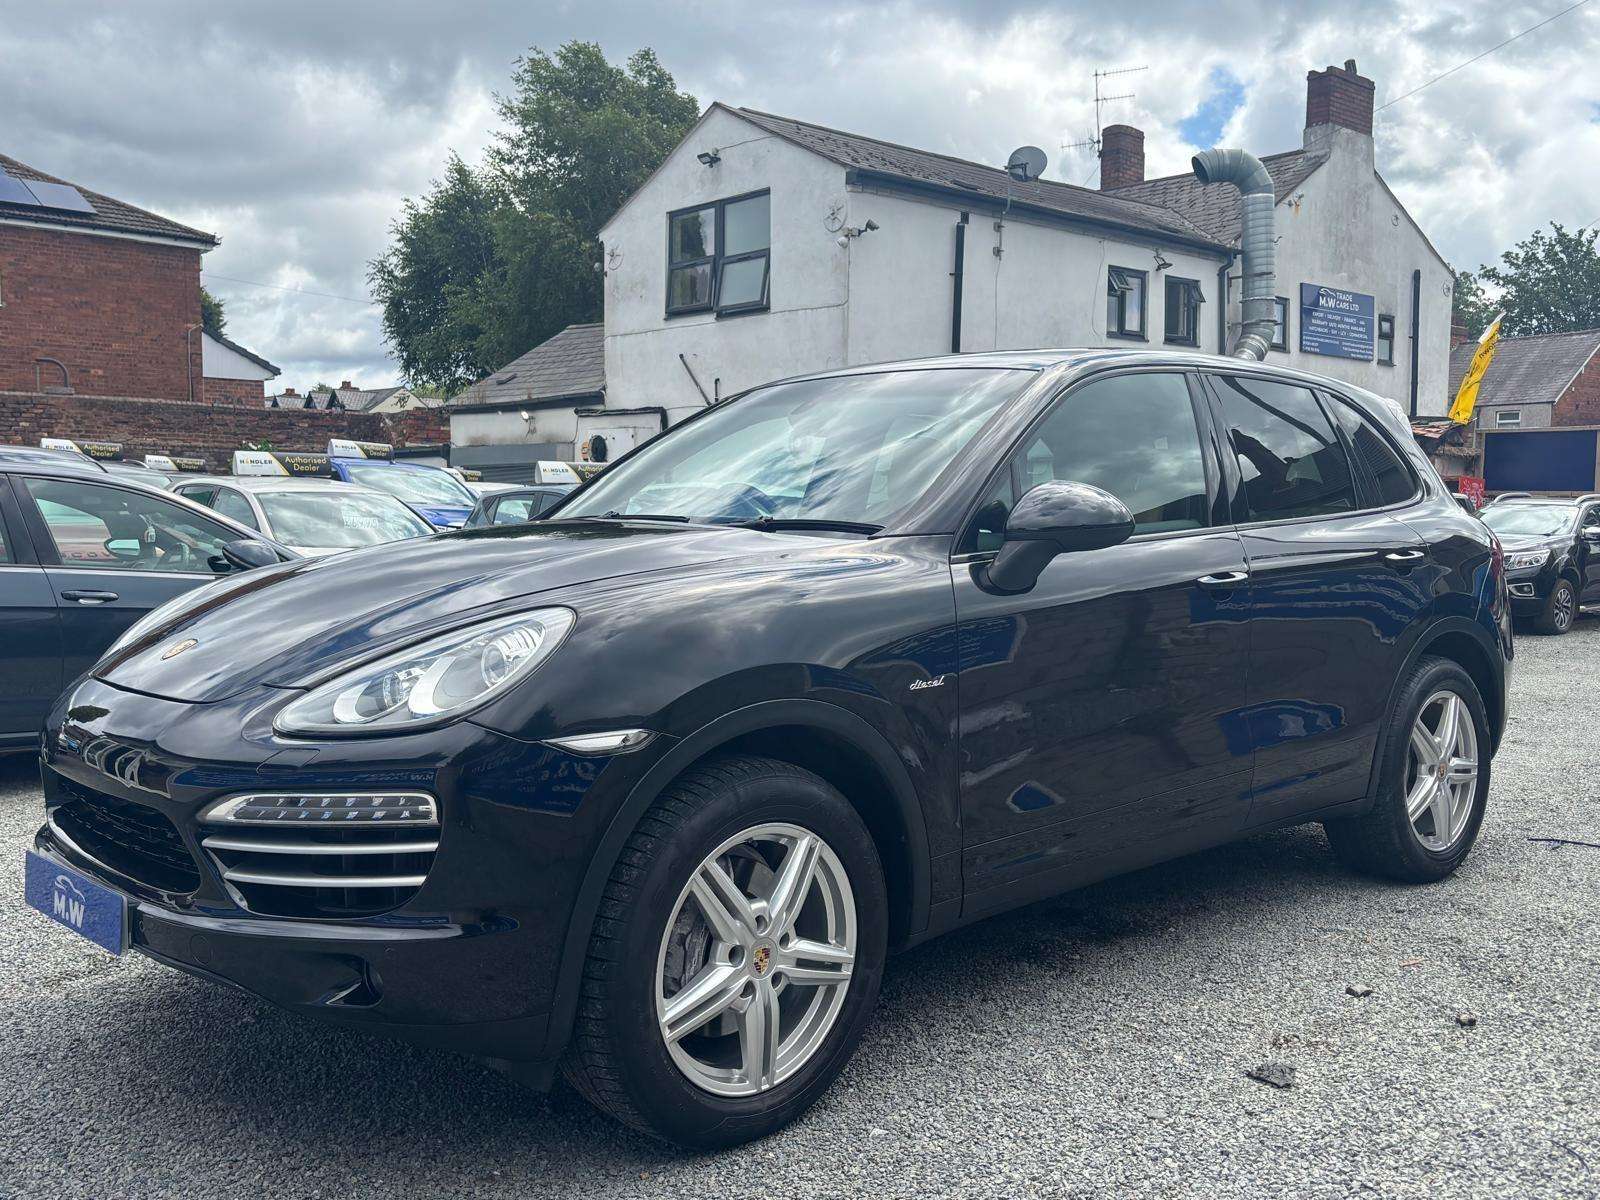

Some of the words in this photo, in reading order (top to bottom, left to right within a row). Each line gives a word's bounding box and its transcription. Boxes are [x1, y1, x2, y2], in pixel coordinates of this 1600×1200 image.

[1336, 292, 1353, 302] TRADE
[1336, 301, 1350, 310] CARS
[1350, 304, 1360, 312] LTD
[83, 443, 120, 452] Authorised
[240, 457, 273, 465] HANDLER
[285, 456, 327, 464] Authorised
[293, 463, 320, 471] Dealer
[909, 675, 945, 690] diesel
[53, 889, 85, 929] M.W
